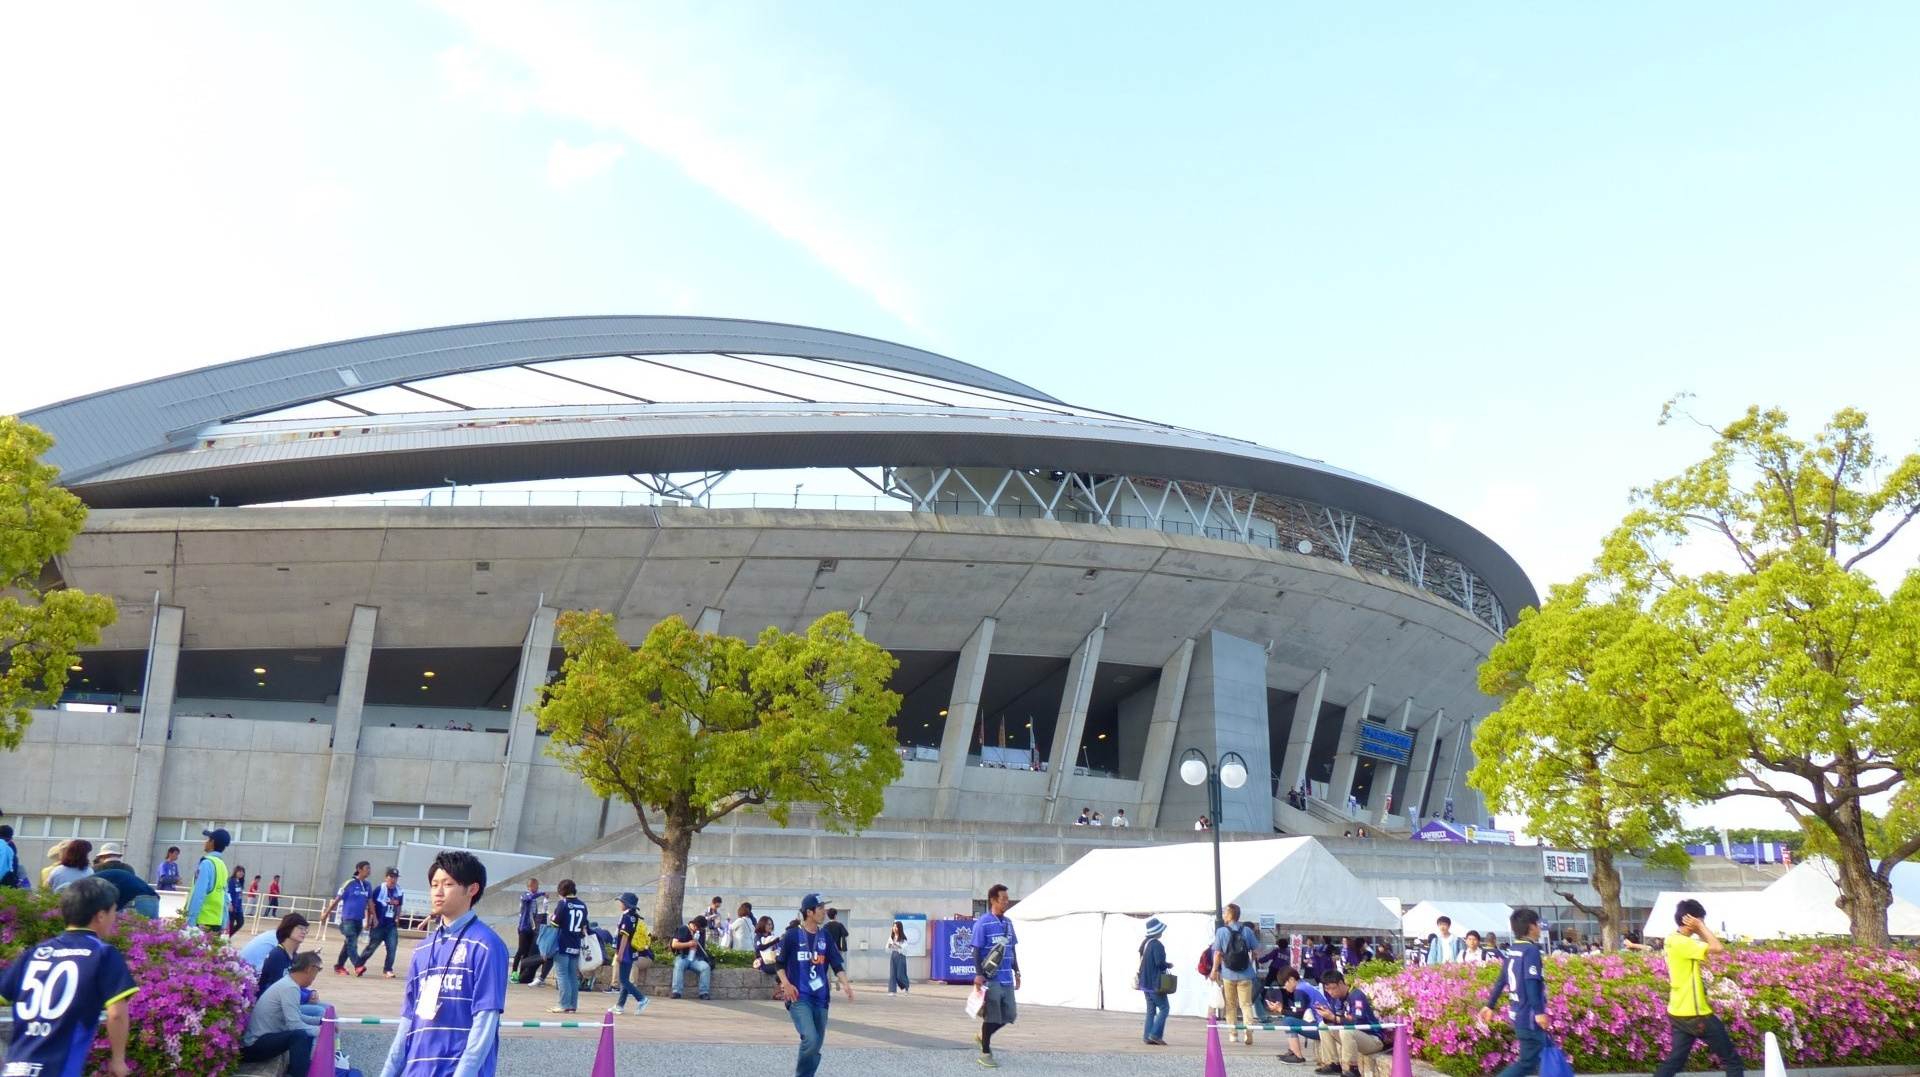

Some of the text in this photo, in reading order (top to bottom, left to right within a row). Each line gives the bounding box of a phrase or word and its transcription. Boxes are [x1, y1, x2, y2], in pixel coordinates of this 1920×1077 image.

[1546, 856, 1586, 873] 朝日新聞
[569, 909, 583, 932] 12
[16, 960, 79, 1020] 50
